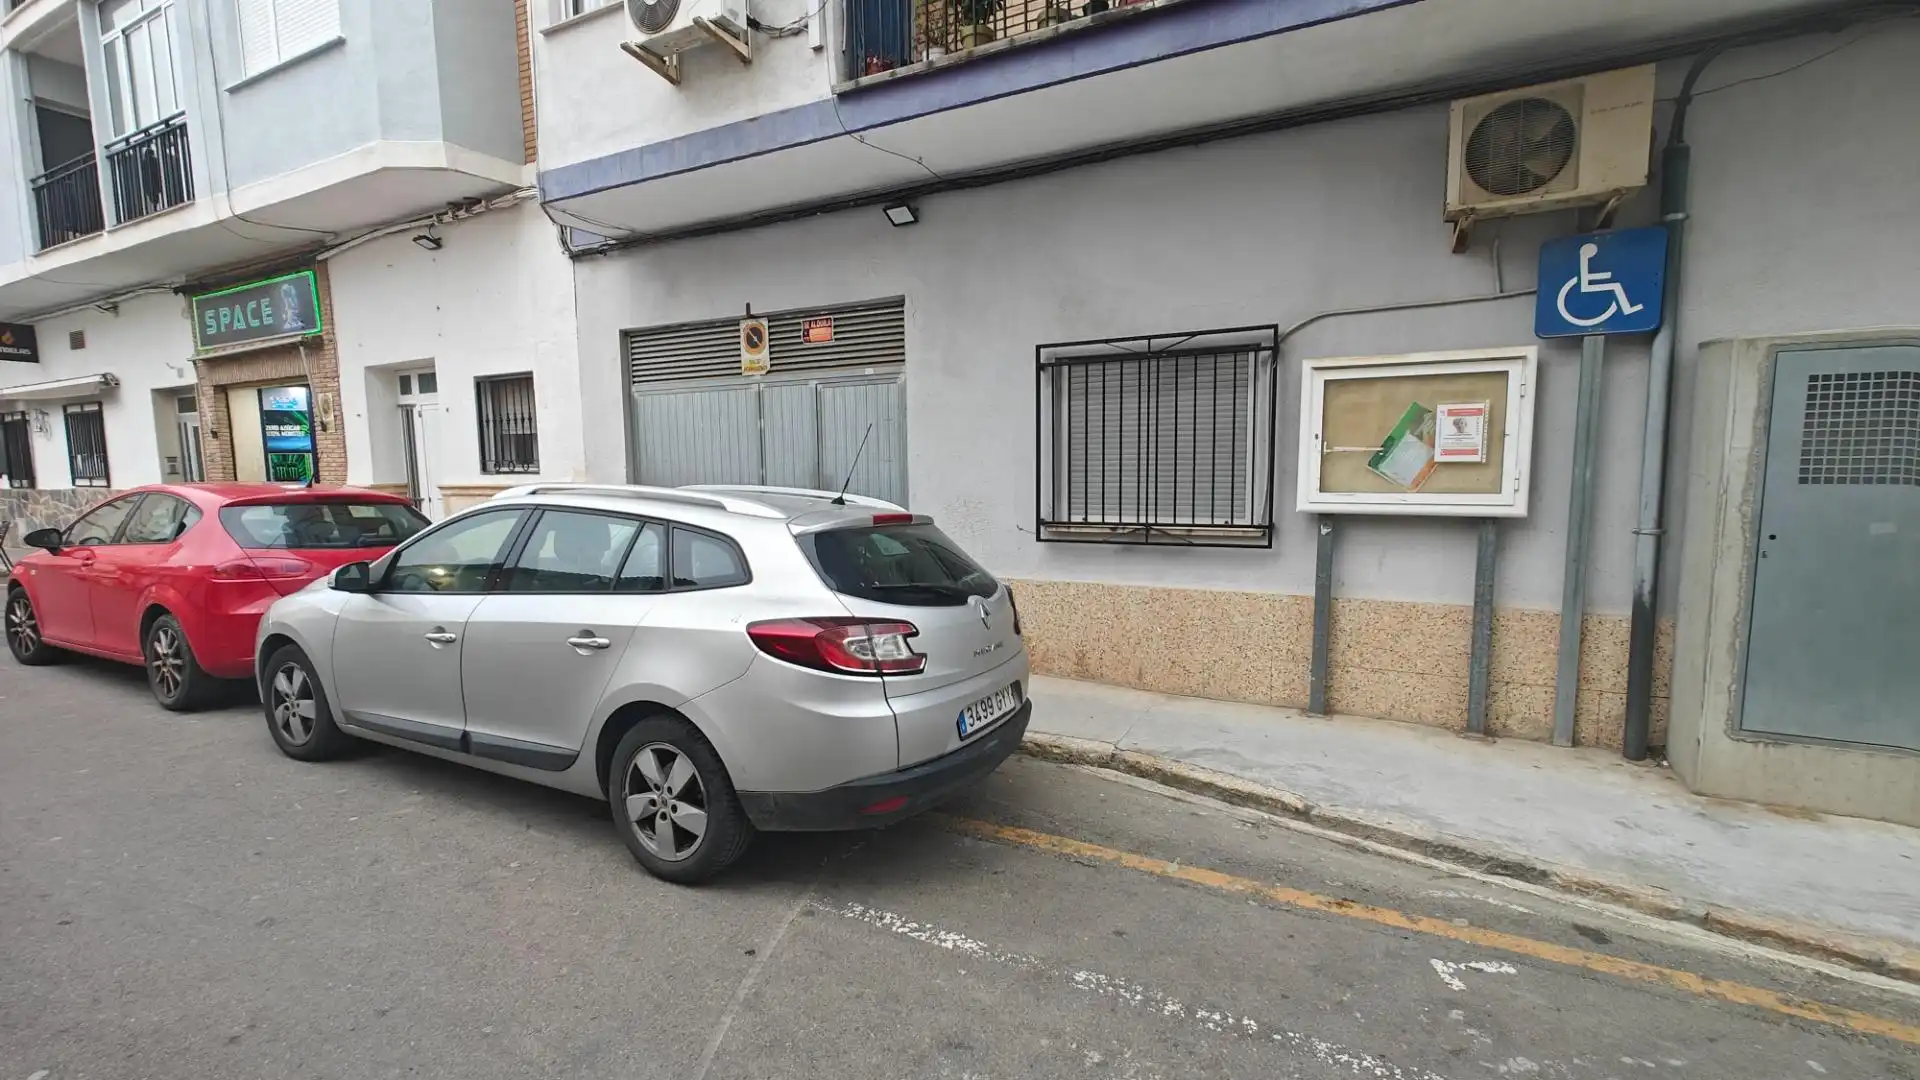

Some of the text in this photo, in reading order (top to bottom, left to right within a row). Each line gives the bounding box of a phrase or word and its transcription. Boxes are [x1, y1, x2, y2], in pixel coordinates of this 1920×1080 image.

[204, 298, 273, 334] SPACE
[967, 685, 1012, 727] 3499 GYY
